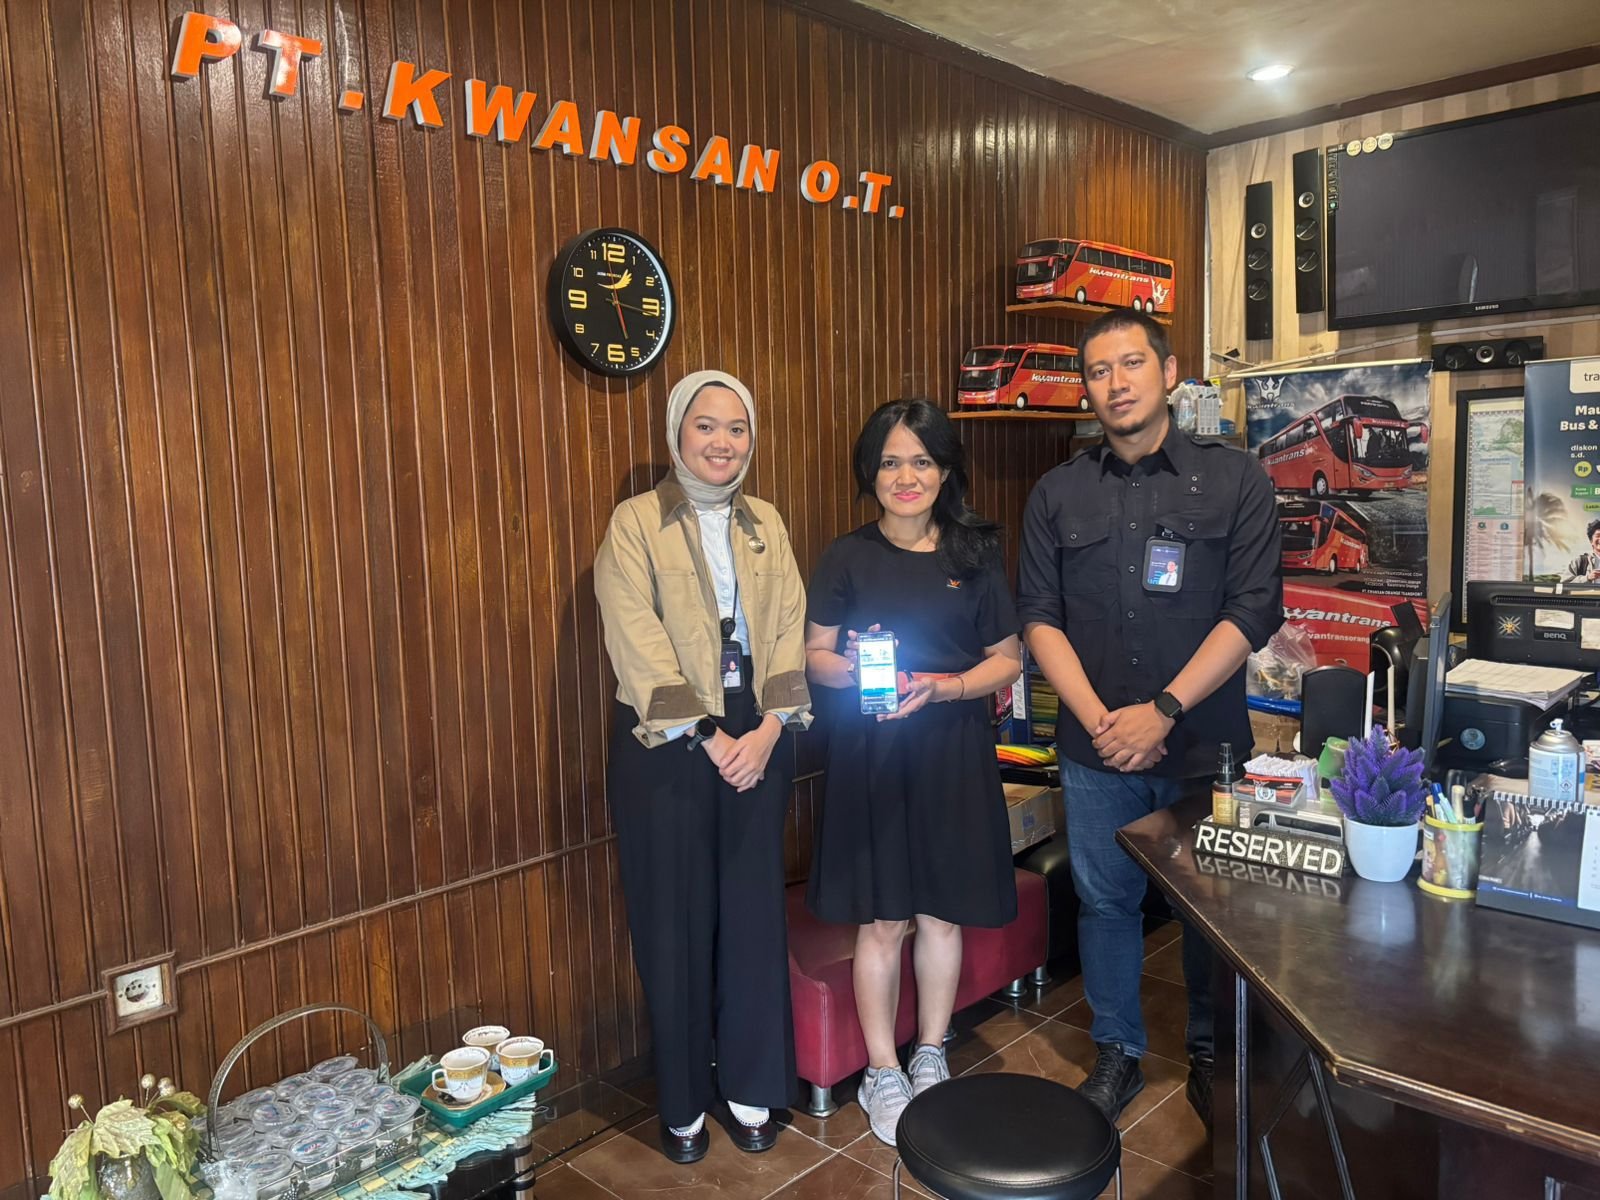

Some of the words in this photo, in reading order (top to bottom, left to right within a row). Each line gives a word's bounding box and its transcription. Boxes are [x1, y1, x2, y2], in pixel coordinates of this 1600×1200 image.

[800, 160, 905, 219] O.T.
[602, 242, 625, 263] 12
[573, 267, 584, 278] 10
[645, 276, 655, 287] 2
[568, 289, 587, 309] 9
[642, 297, 660, 317] 3
[575, 323, 585, 334] 8
[590, 342, 600, 354] 7
[607, 343, 626, 363] 6
[630, 346, 640, 357] 5
[1031, 373, 1082, 384] kwantran
[1583, 372, 1600, 381] tra
[1560, 420, 1586, 430] Bus
[1588, 419, 1598, 430] &
[1570, 444, 1598, 452] diskon
[1196, 825, 1342, 874] RESERVED
